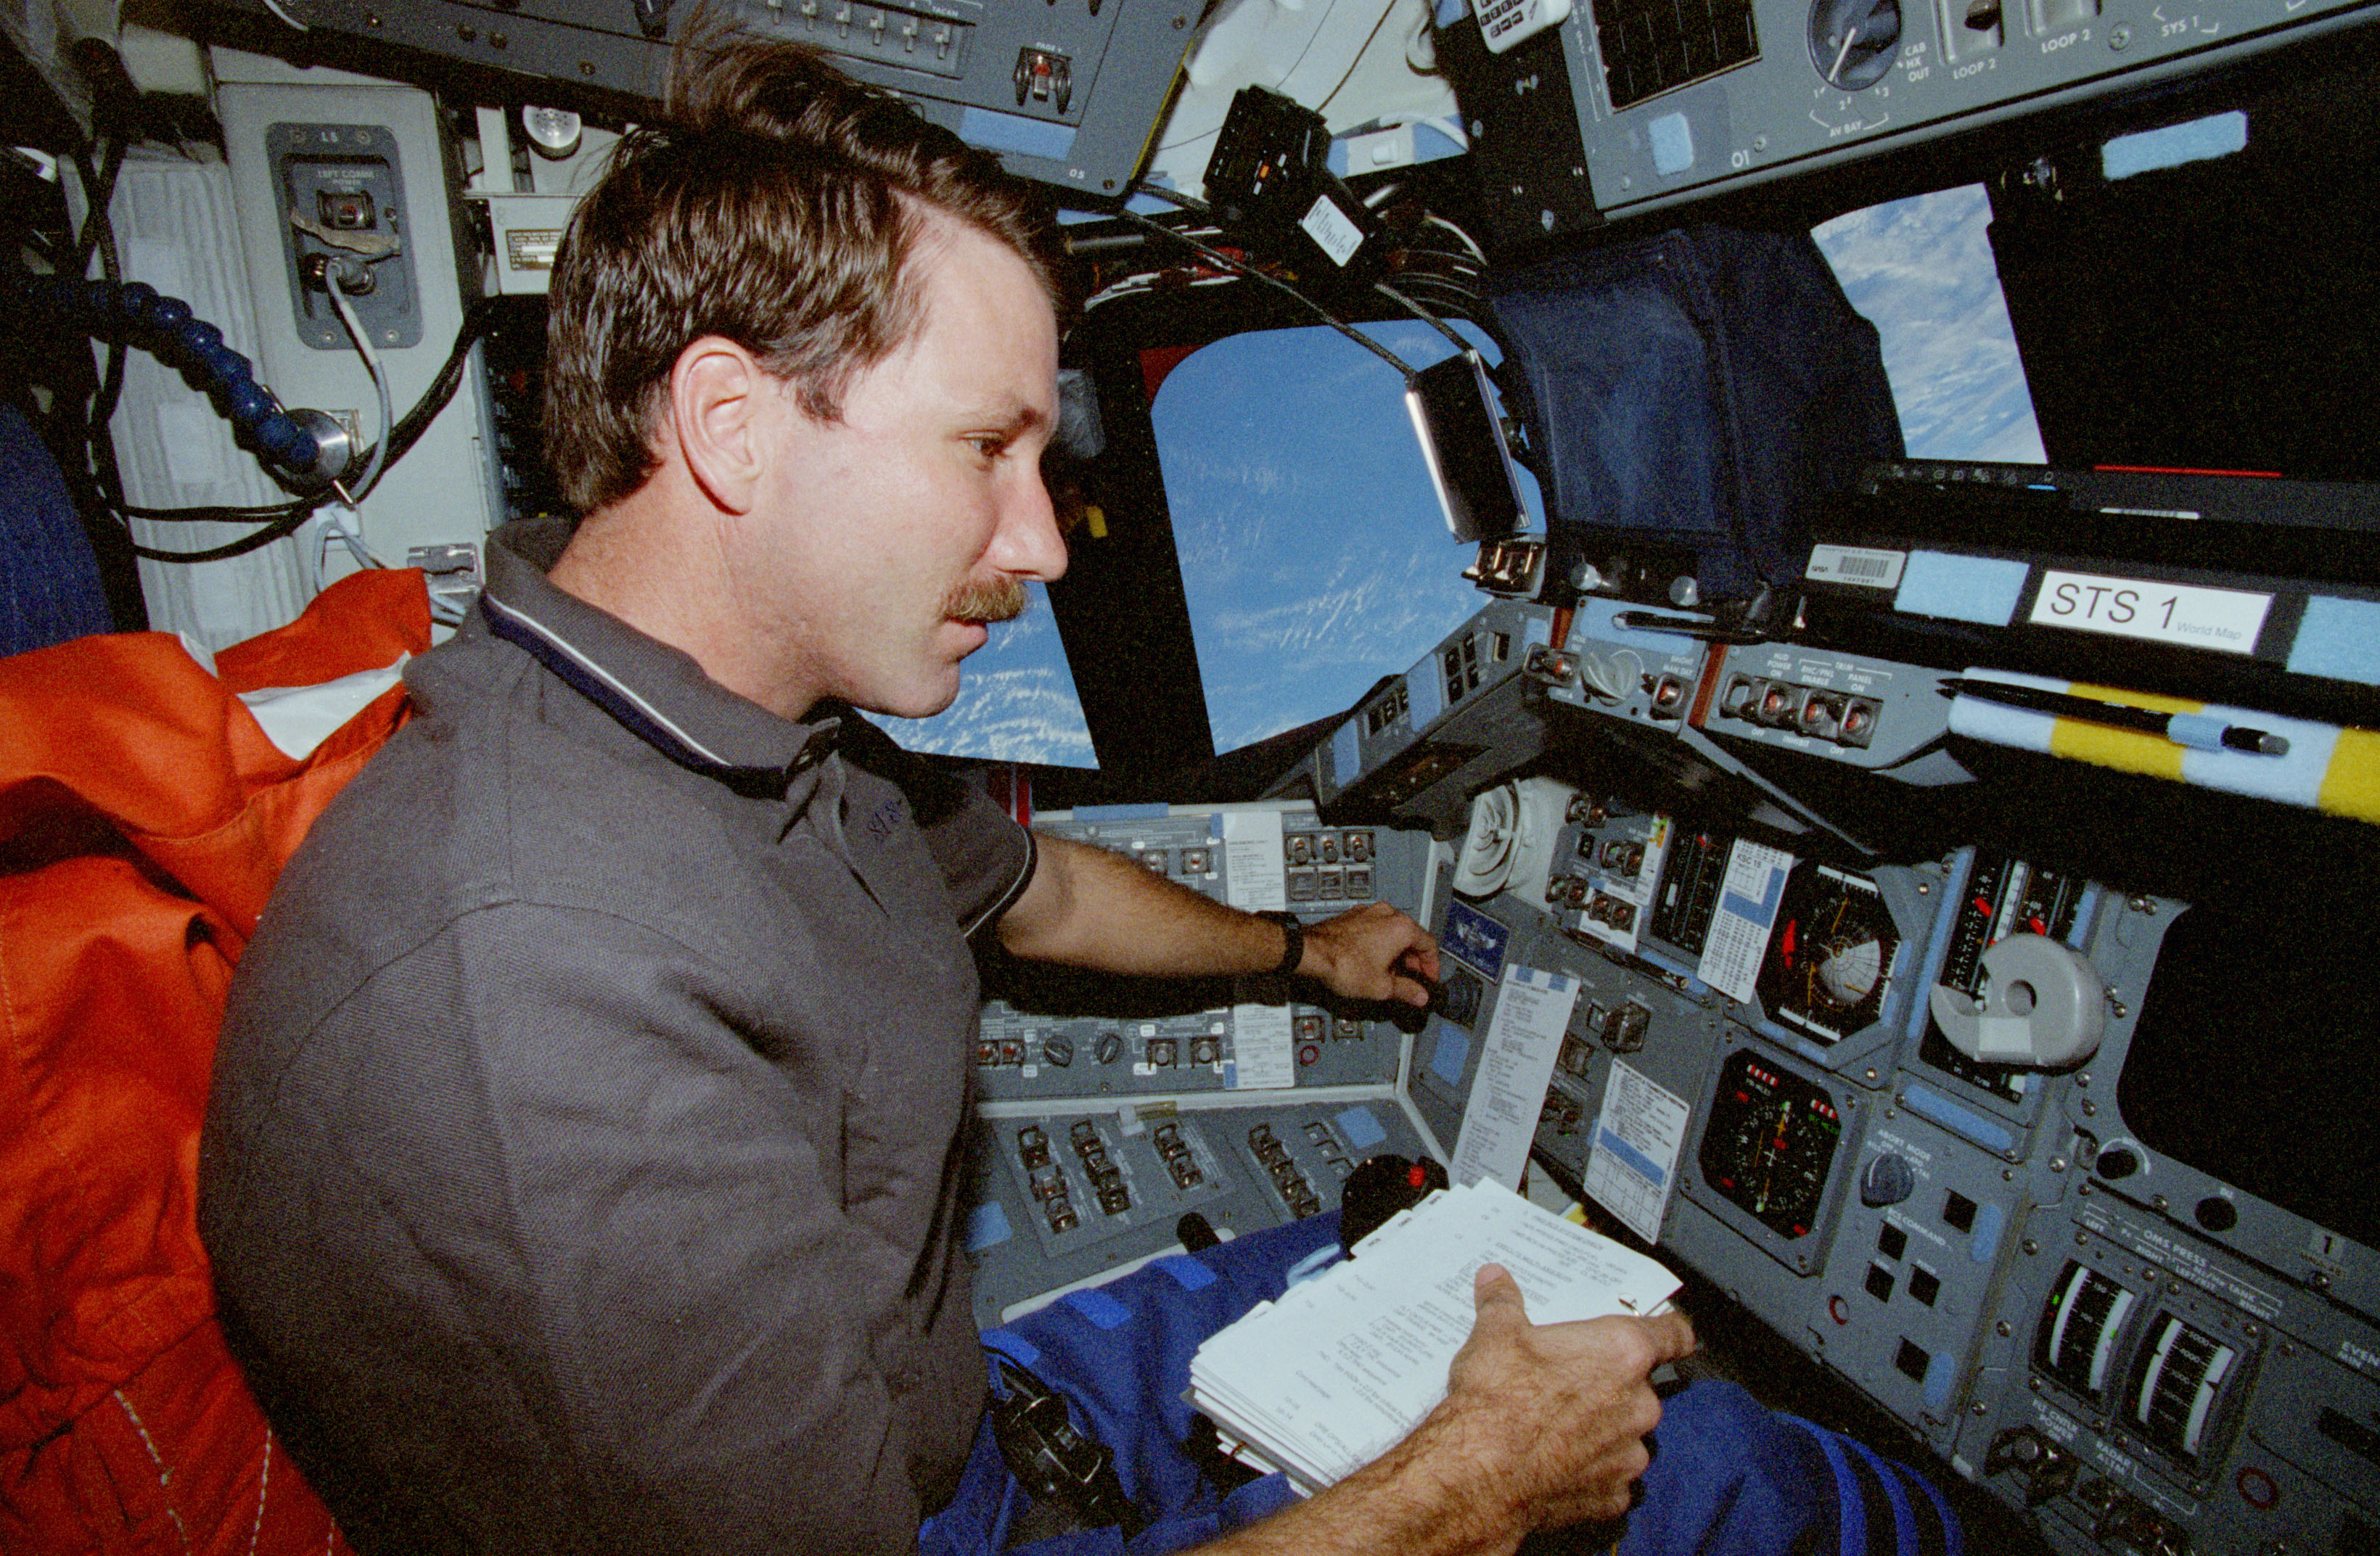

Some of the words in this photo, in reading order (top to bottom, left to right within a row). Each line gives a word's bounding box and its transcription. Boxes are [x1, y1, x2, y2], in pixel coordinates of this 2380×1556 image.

[2162, 22, 2186, 37] SYS
[2193, 16, 2198, 28] 1
[2042, 33, 2077, 54] LOOP
[2082, 28, 2090, 41] 2
[1905, 42, 1926, 56] CAB
[1906, 57, 1922, 70] HX
[1953, 62, 1985, 80] LOOP
[1989, 58, 1997, 70] 2
[1908, 66, 1930, 82] OUT
[1814, 88, 1818, 99] 1
[1883, 86, 1889, 97] 3
[1839, 100, 1846, 110] 2
[1829, 126, 1842, 138] AV
[1844, 121, 1862, 133] BAY
[2051, 583, 2140, 623] STS
[2161, 596, 2178, 629] 1
[2177, 622, 2213, 637] World
[2215, 627, 2242, 641] Map
[1767, 660, 1792, 670] POWER
[1835, 662, 1854, 671] TRIM
[1801, 675, 1830, 686] ENABLE
[1848, 673, 1872, 684] PANEL
[1851, 683, 1865, 692] ON
[1752, 728, 1765, 737] OFF
[1783, 736, 1810, 746] INHIBIT
[1829, 746, 1846, 755] OFF
[1736, 854, 1752, 864] KSC
[1878, 1129, 1905, 1146] ABORT
[1906, 1143, 1932, 1161] MODE
[1903, 1217, 1946, 1246] COMMAND
[2085, 1219, 2104, 1232] LEFT
[2135, 1245, 2164, 1264] RIGHT
[2143, 1230, 2170, 1248] OMS
[2172, 1244, 2207, 1267] PRESS
[2228, 1283, 2255, 1302] TANK
[2239, 1298, 2272, 1320] RIGHT
[2039, 1414, 2074, 1442] POWER
[2096, 1440, 2131, 1468] RADAR
